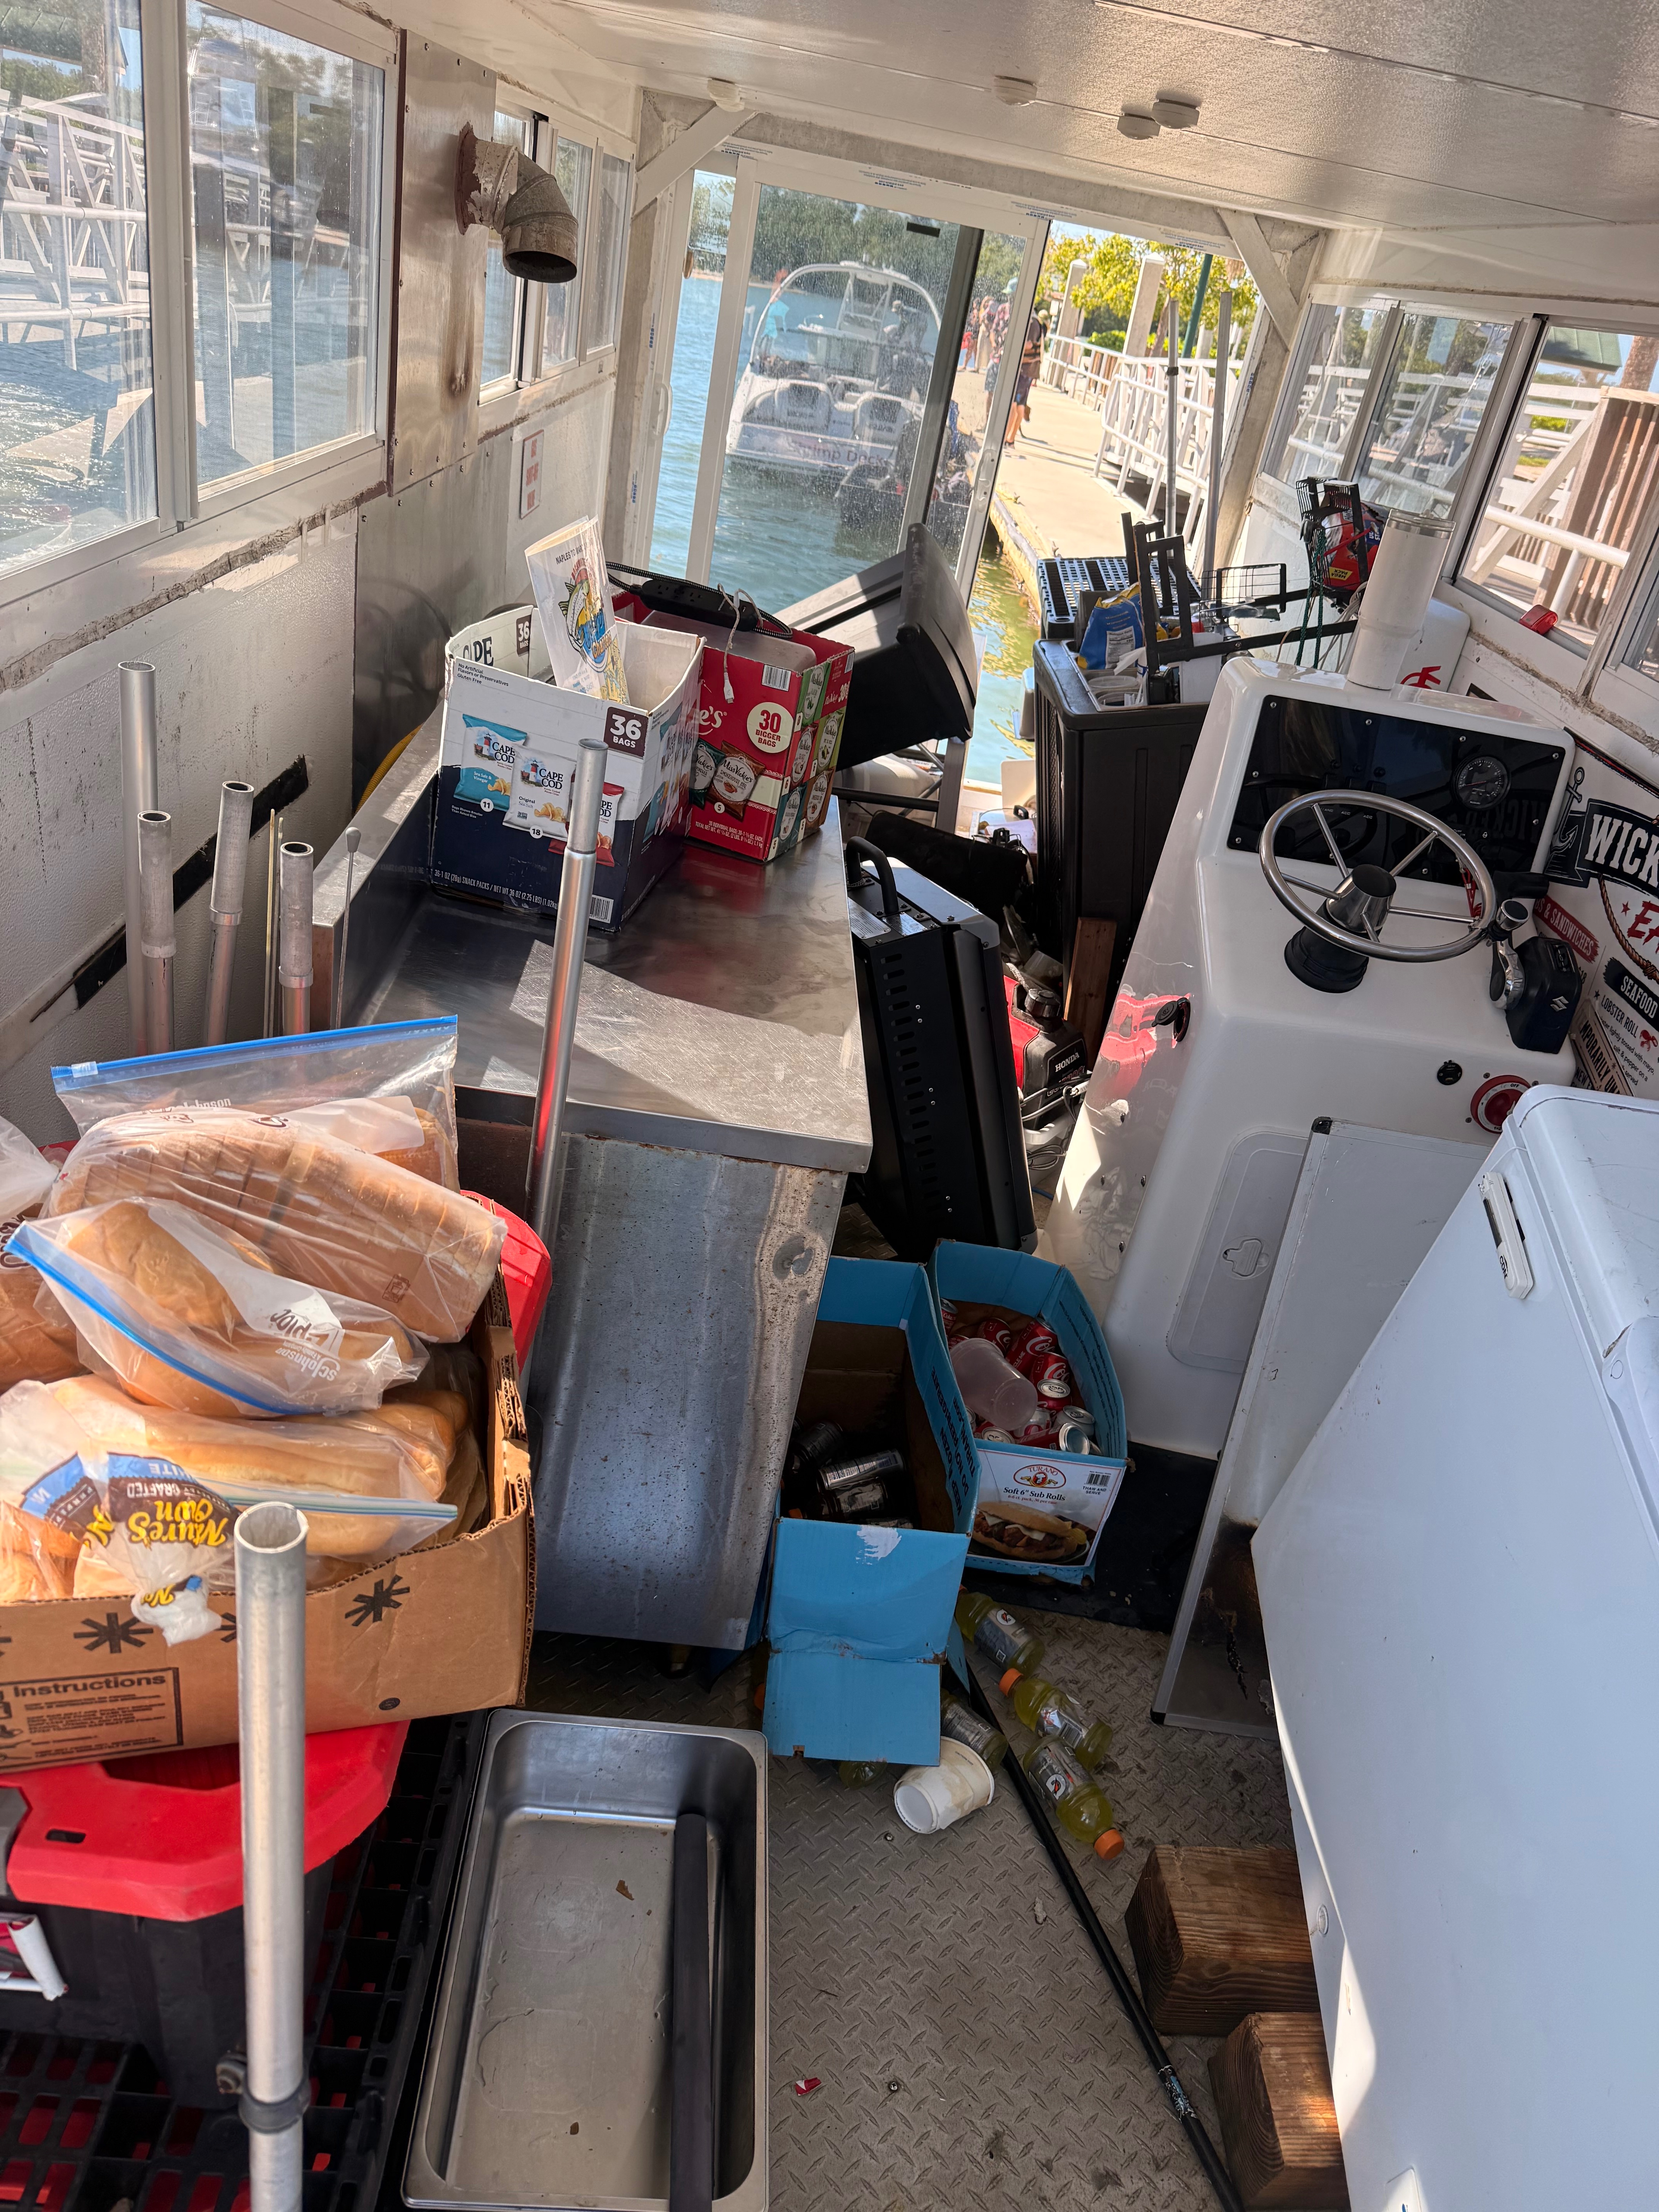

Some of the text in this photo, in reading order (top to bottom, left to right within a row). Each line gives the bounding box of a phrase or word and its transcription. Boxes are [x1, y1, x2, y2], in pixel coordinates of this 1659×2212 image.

[556, 553, 571, 565] NAPLES
[518, 621, 529, 641] 36
[520, 640, 529, 649] BAGS
[457, 673, 472, 682] Gluten
[458, 668, 473, 676] Flavors
[480, 674, 509, 686] Preservatives
[465, 665, 483, 675] Artificial
[610, 714, 642, 740] 36
[759, 709, 781, 733] 30
[613, 737, 636, 748] BAGS
[755, 729, 781, 742] BIGGER
[757, 737, 776, 748] BAGS
[492, 742, 515, 756] CAPE
[494, 752, 515, 764] COD
[539, 768, 563, 782] CAPE
[541, 778, 562, 790] COD
[785, 781, 788, 789] 6
[532, 828, 541, 836] 18
[696, 821, 704, 829] TOTAL
[462, 877, 476, 887] SNACK
[476, 880, 489, 890] PACKS
[493, 885, 501, 893] NET
[1544, 903, 1551, 919] &
[1550, 908, 1594, 957] SANDWICHES
[1620, 975, 1658, 1018] SEAFOOD
[1601, 994, 1639, 1039] LOBSTER ROLL
[1609, 1024, 1622, 1042] lightly
[1621, 1037, 1635, 1054] tossed
[1634, 1049, 1644, 1063] with
[1642, 1057, 1655, 1075] mayo,
[1055, 1052, 1080, 1072] HONDA
[1613, 1044, 1621, 1054] salt
[1624, 1055, 1638, 1072] pepper
[1638, 1068, 1645, 1076] on
[1575, 1066, 1588, 1084] NEW
[1625, 1069, 1638, 1086] served
[931, 1365, 959, 1448] REFRIGERATE
[1027, 1465, 1058, 1476] TURANO
[126, 1482, 180, 1498] CRAFTED
[961, 1473, 970, 1497] DO
[951, 1480, 963, 1516] KEEP
[1003, 1486, 1019, 1495] Soft
[1046, 1492, 1066, 1502] Rolls
[153, 1498, 213, 1525] Own
[14, 1674, 166, 1697] Instructions
